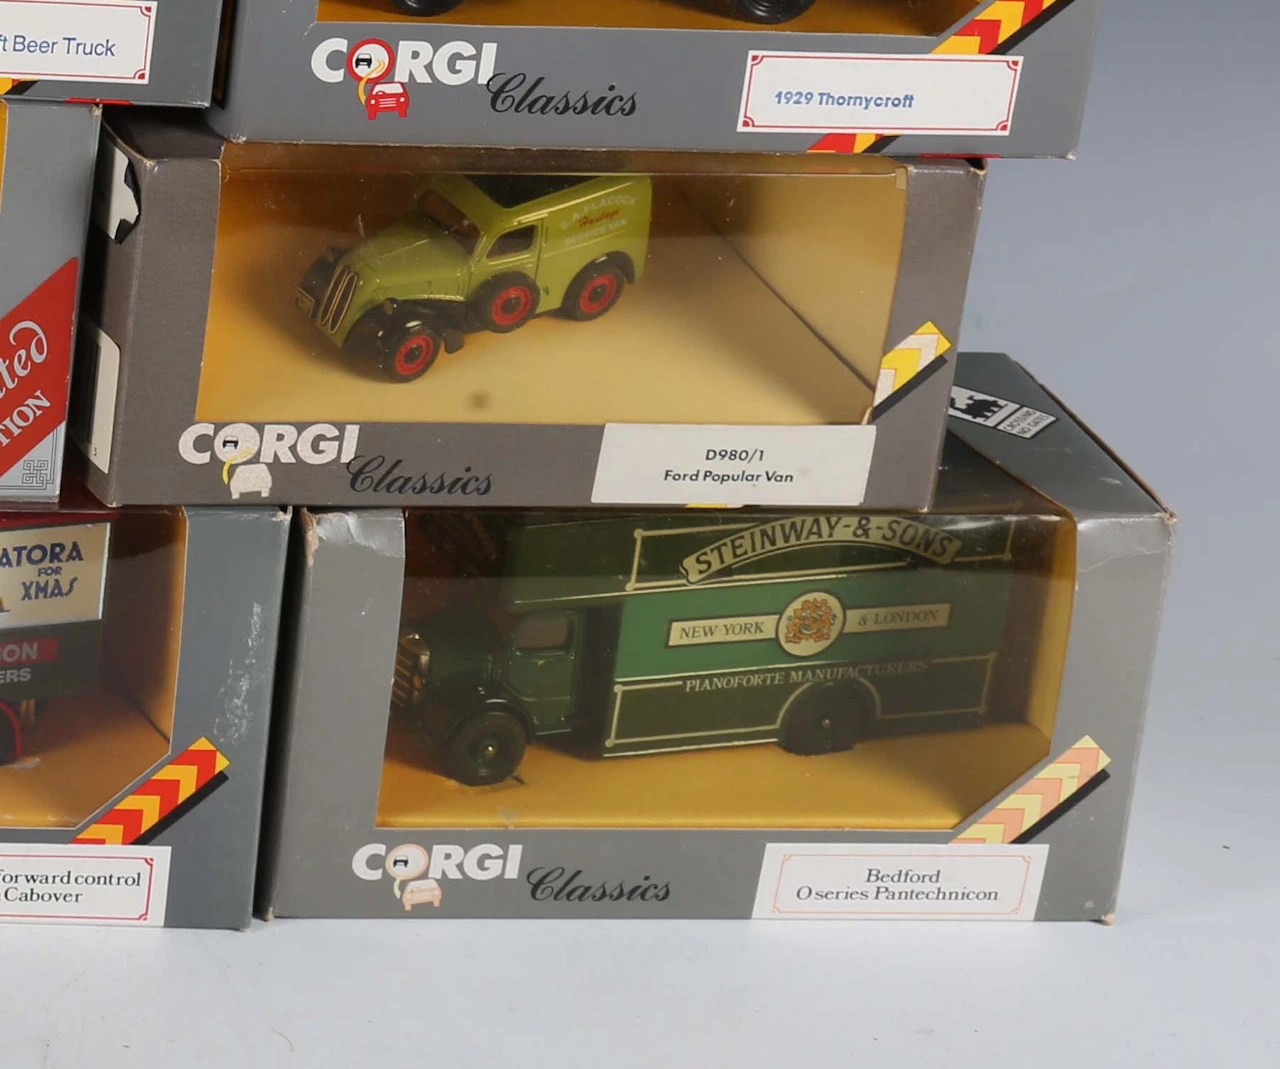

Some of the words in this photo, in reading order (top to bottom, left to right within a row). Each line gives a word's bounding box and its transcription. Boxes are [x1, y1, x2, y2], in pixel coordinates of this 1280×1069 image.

[12, 35, 59, 55] Beer
[62, 36, 117, 58] Truck
[310, 38, 497, 86] CORGI
[484, 72, 638, 119] Classics
[774, 90, 814, 109] 1929
[817, 90, 915, 113] Thornycroft
[178, 423, 358, 465] CORGI
[705, 447, 766, 464] D980/1
[346, 456, 493, 497] Classics
[663, 468, 695, 484] Ford
[699, 468, 762, 487] Popular
[763, 469, 795, 484] Van
[37, 566, 63, 577] FOR
[20, 576, 79, 601] XMAS
[857, 615, 869, 626] &
[874, 609, 939, 625] LONDON
[685, 672, 785, 692] PIANOFORTE
[789, 660, 929, 683] MANUFACTURERS
[351, 843, 522, 881] CORGI
[73, 869, 141, 888] control
[527, 867, 671, 904] Classics
[864, 867, 940, 885] Bedford
[2, 887, 84, 905] Cabover
[814, 886, 870, 901] series
[873, 886, 999, 902] Pantechnicon
